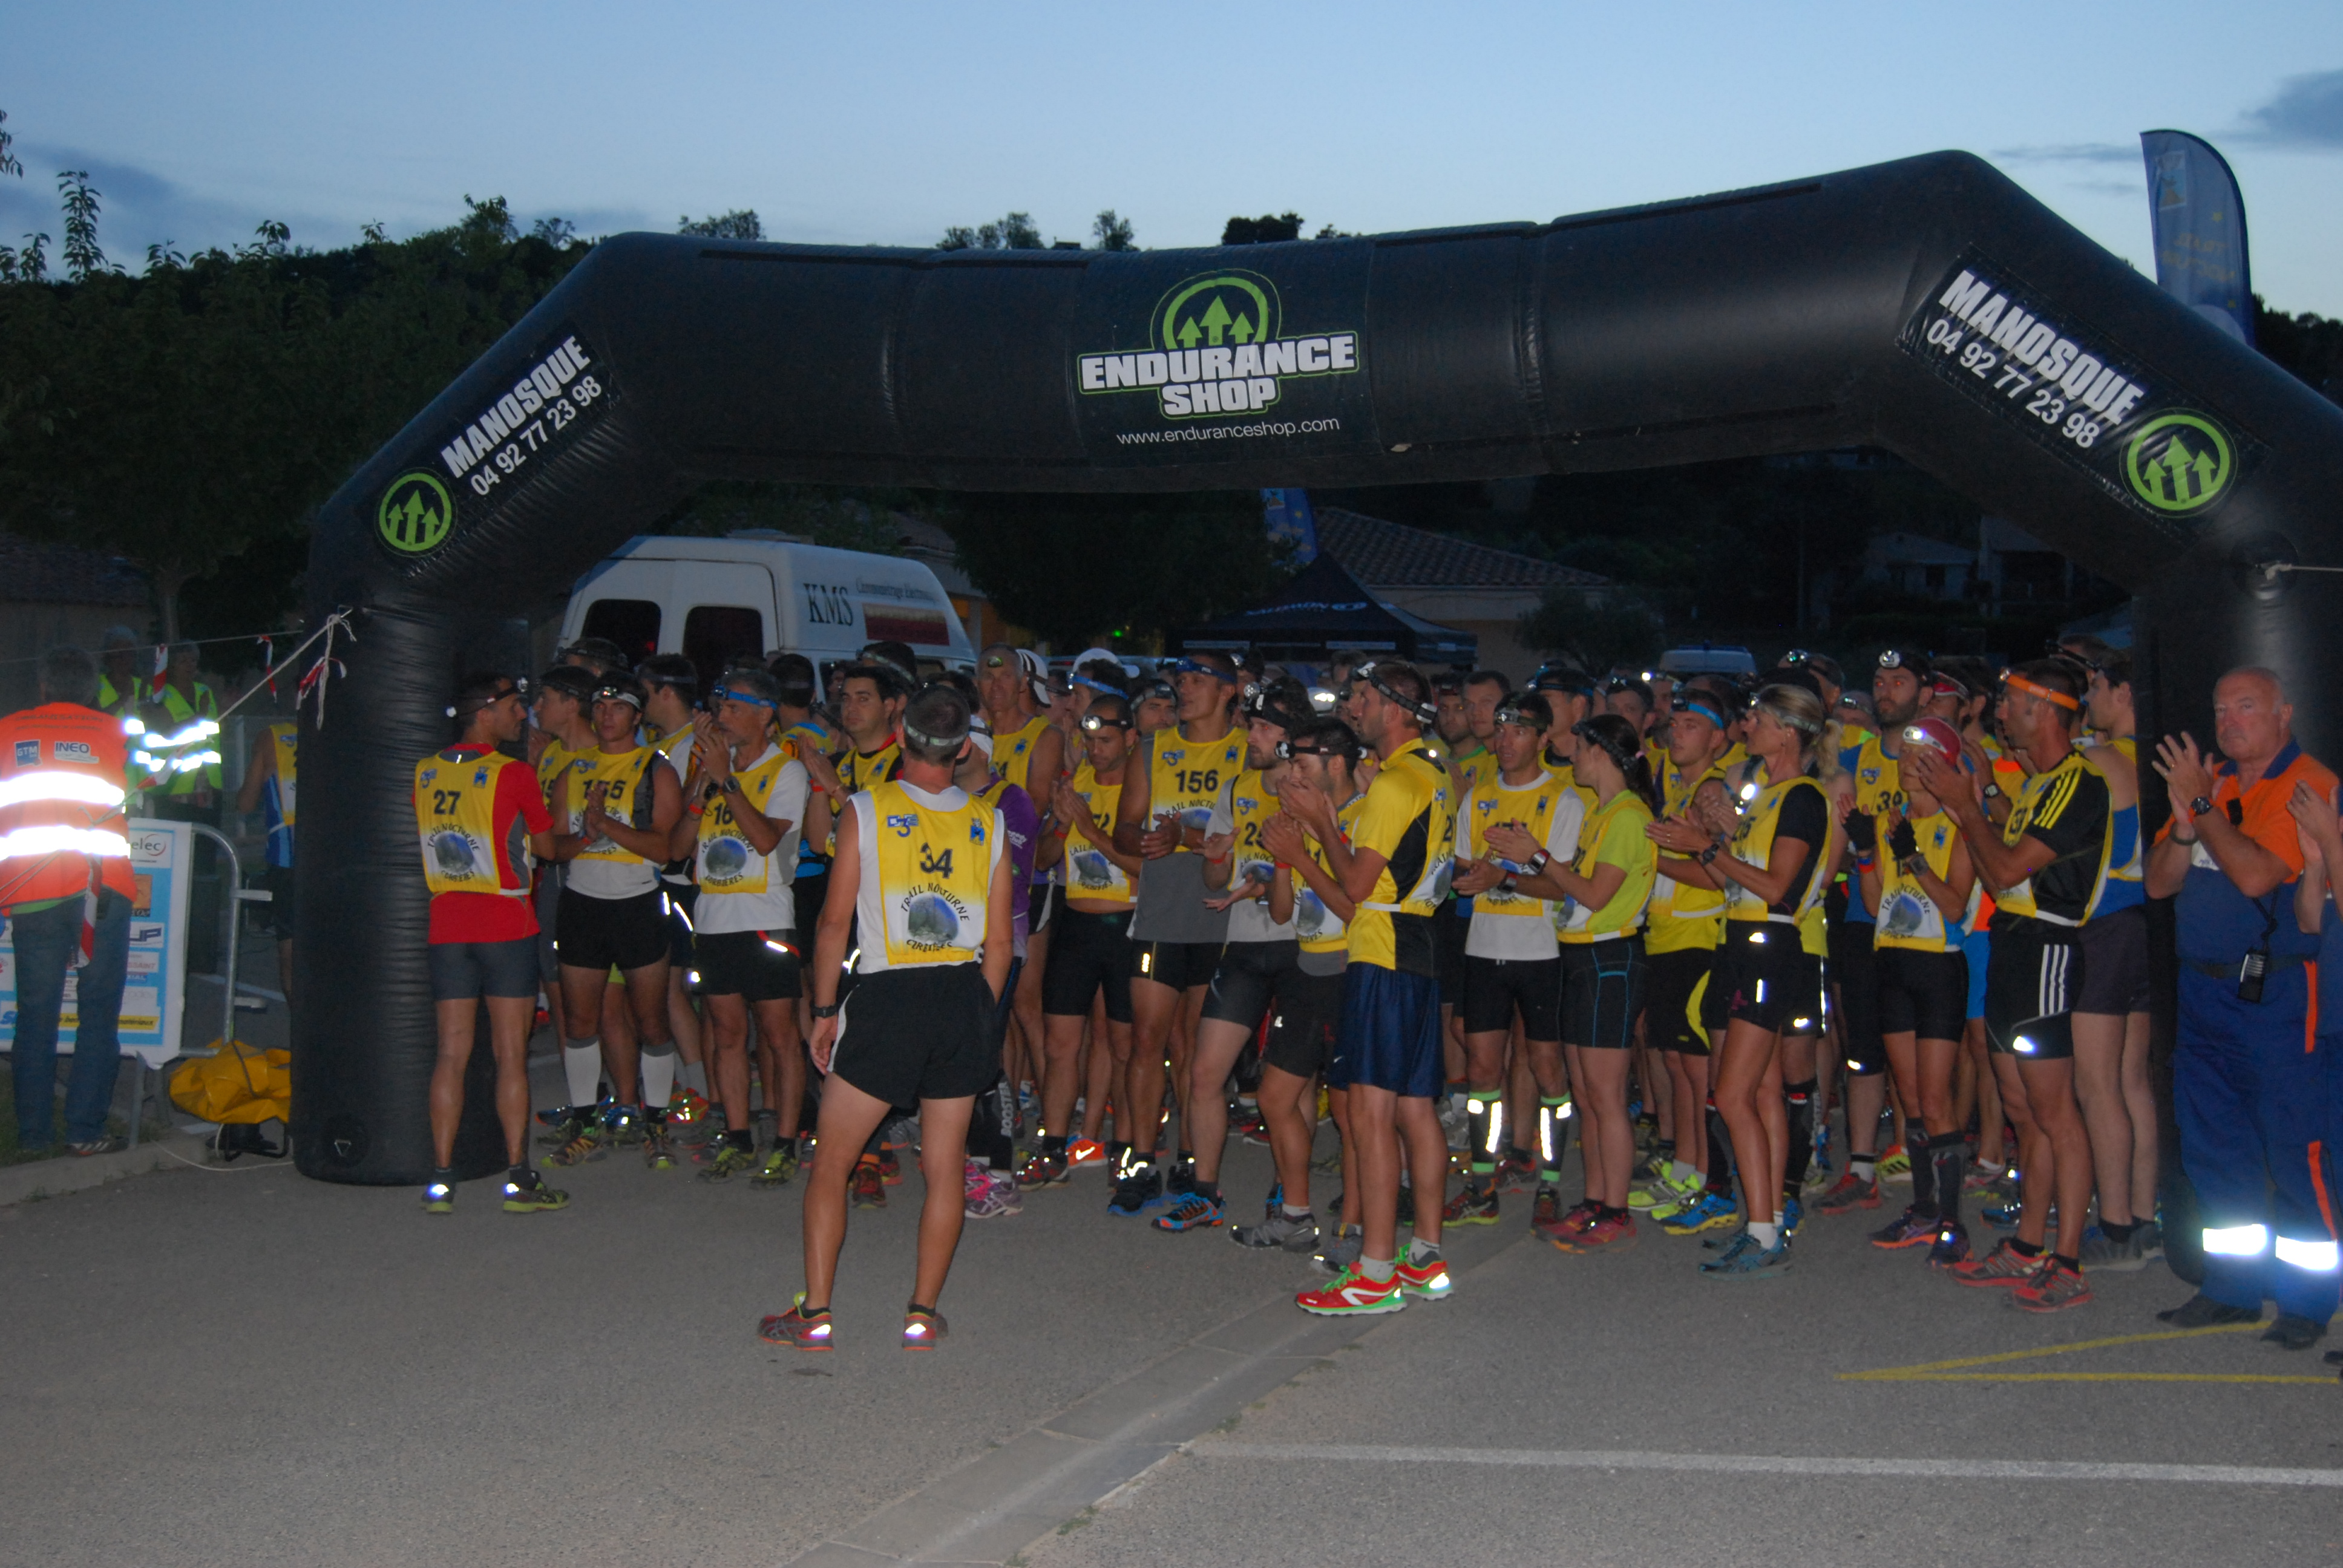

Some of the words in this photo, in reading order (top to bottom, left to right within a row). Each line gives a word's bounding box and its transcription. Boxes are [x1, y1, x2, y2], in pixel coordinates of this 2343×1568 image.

[1081, 335, 1354, 390] ENDURANCE
[1938, 270, 2145, 425] MANOSQUE
[1162, 377, 1276, 415] SHOP
[1927, 319, 1958, 355] 04
[1959, 343, 1996, 379] 92
[1994, 364, 2032, 399] 77
[2026, 389, 2065, 425] 23
[2062, 412, 2100, 448] 98
[441, 336, 591, 479] MANOSQUE
[471, 465, 500, 496] 04
[496, 443, 526, 474] 92
[520, 420, 549, 452] 77
[546, 399, 577, 431] 23
[572, 375, 602, 407] 98
[1116, 418, 1340, 445] www.enduranceshop.com
[804, 583, 853, 626] KMS
[17, 745, 38, 756] GTM
[56, 742, 90, 753] INEO
[1175, 769, 1219, 793] 156
[433, 789, 461, 815] 27
[1165, 801, 1185, 817] RAIL
[919, 842, 953, 879] 34
[901, 885, 924, 912] TRAIL
[928, 883, 969, 921] NOCTURNE
[998, 1082, 1013, 1137] BOOSTER
